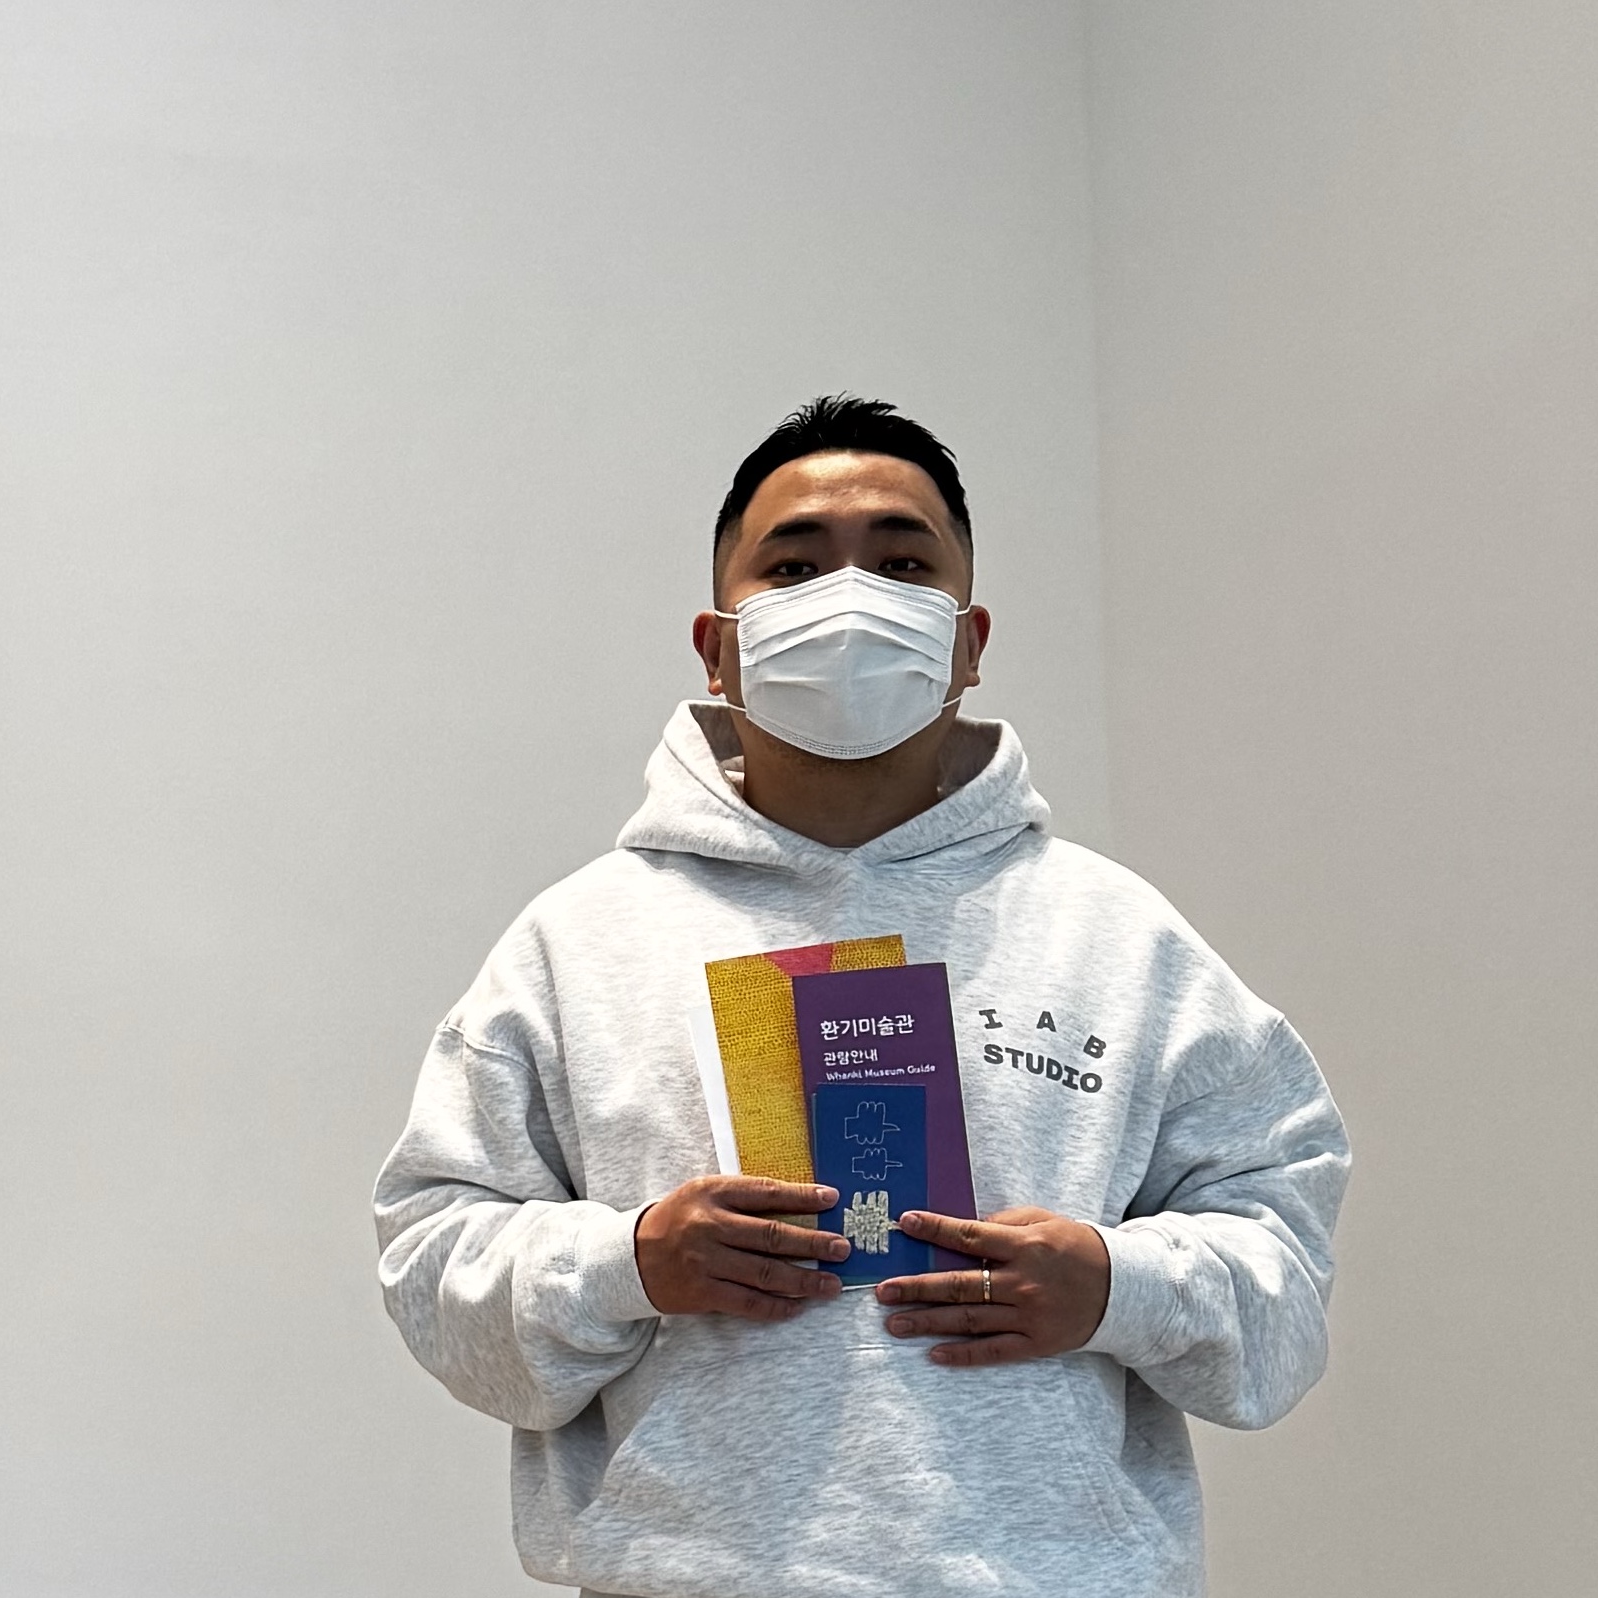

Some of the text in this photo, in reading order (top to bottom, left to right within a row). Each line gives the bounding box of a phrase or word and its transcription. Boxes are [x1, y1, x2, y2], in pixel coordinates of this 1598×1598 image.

[820, 1013, 916, 1041] 환기미술관
[823, 1047, 879, 1067] 관람안내
[983, 1043, 1103, 1094] STUDIO
[864, 1067, 905, 1079] Museum
[906, 1063, 937, 1075] Guide
